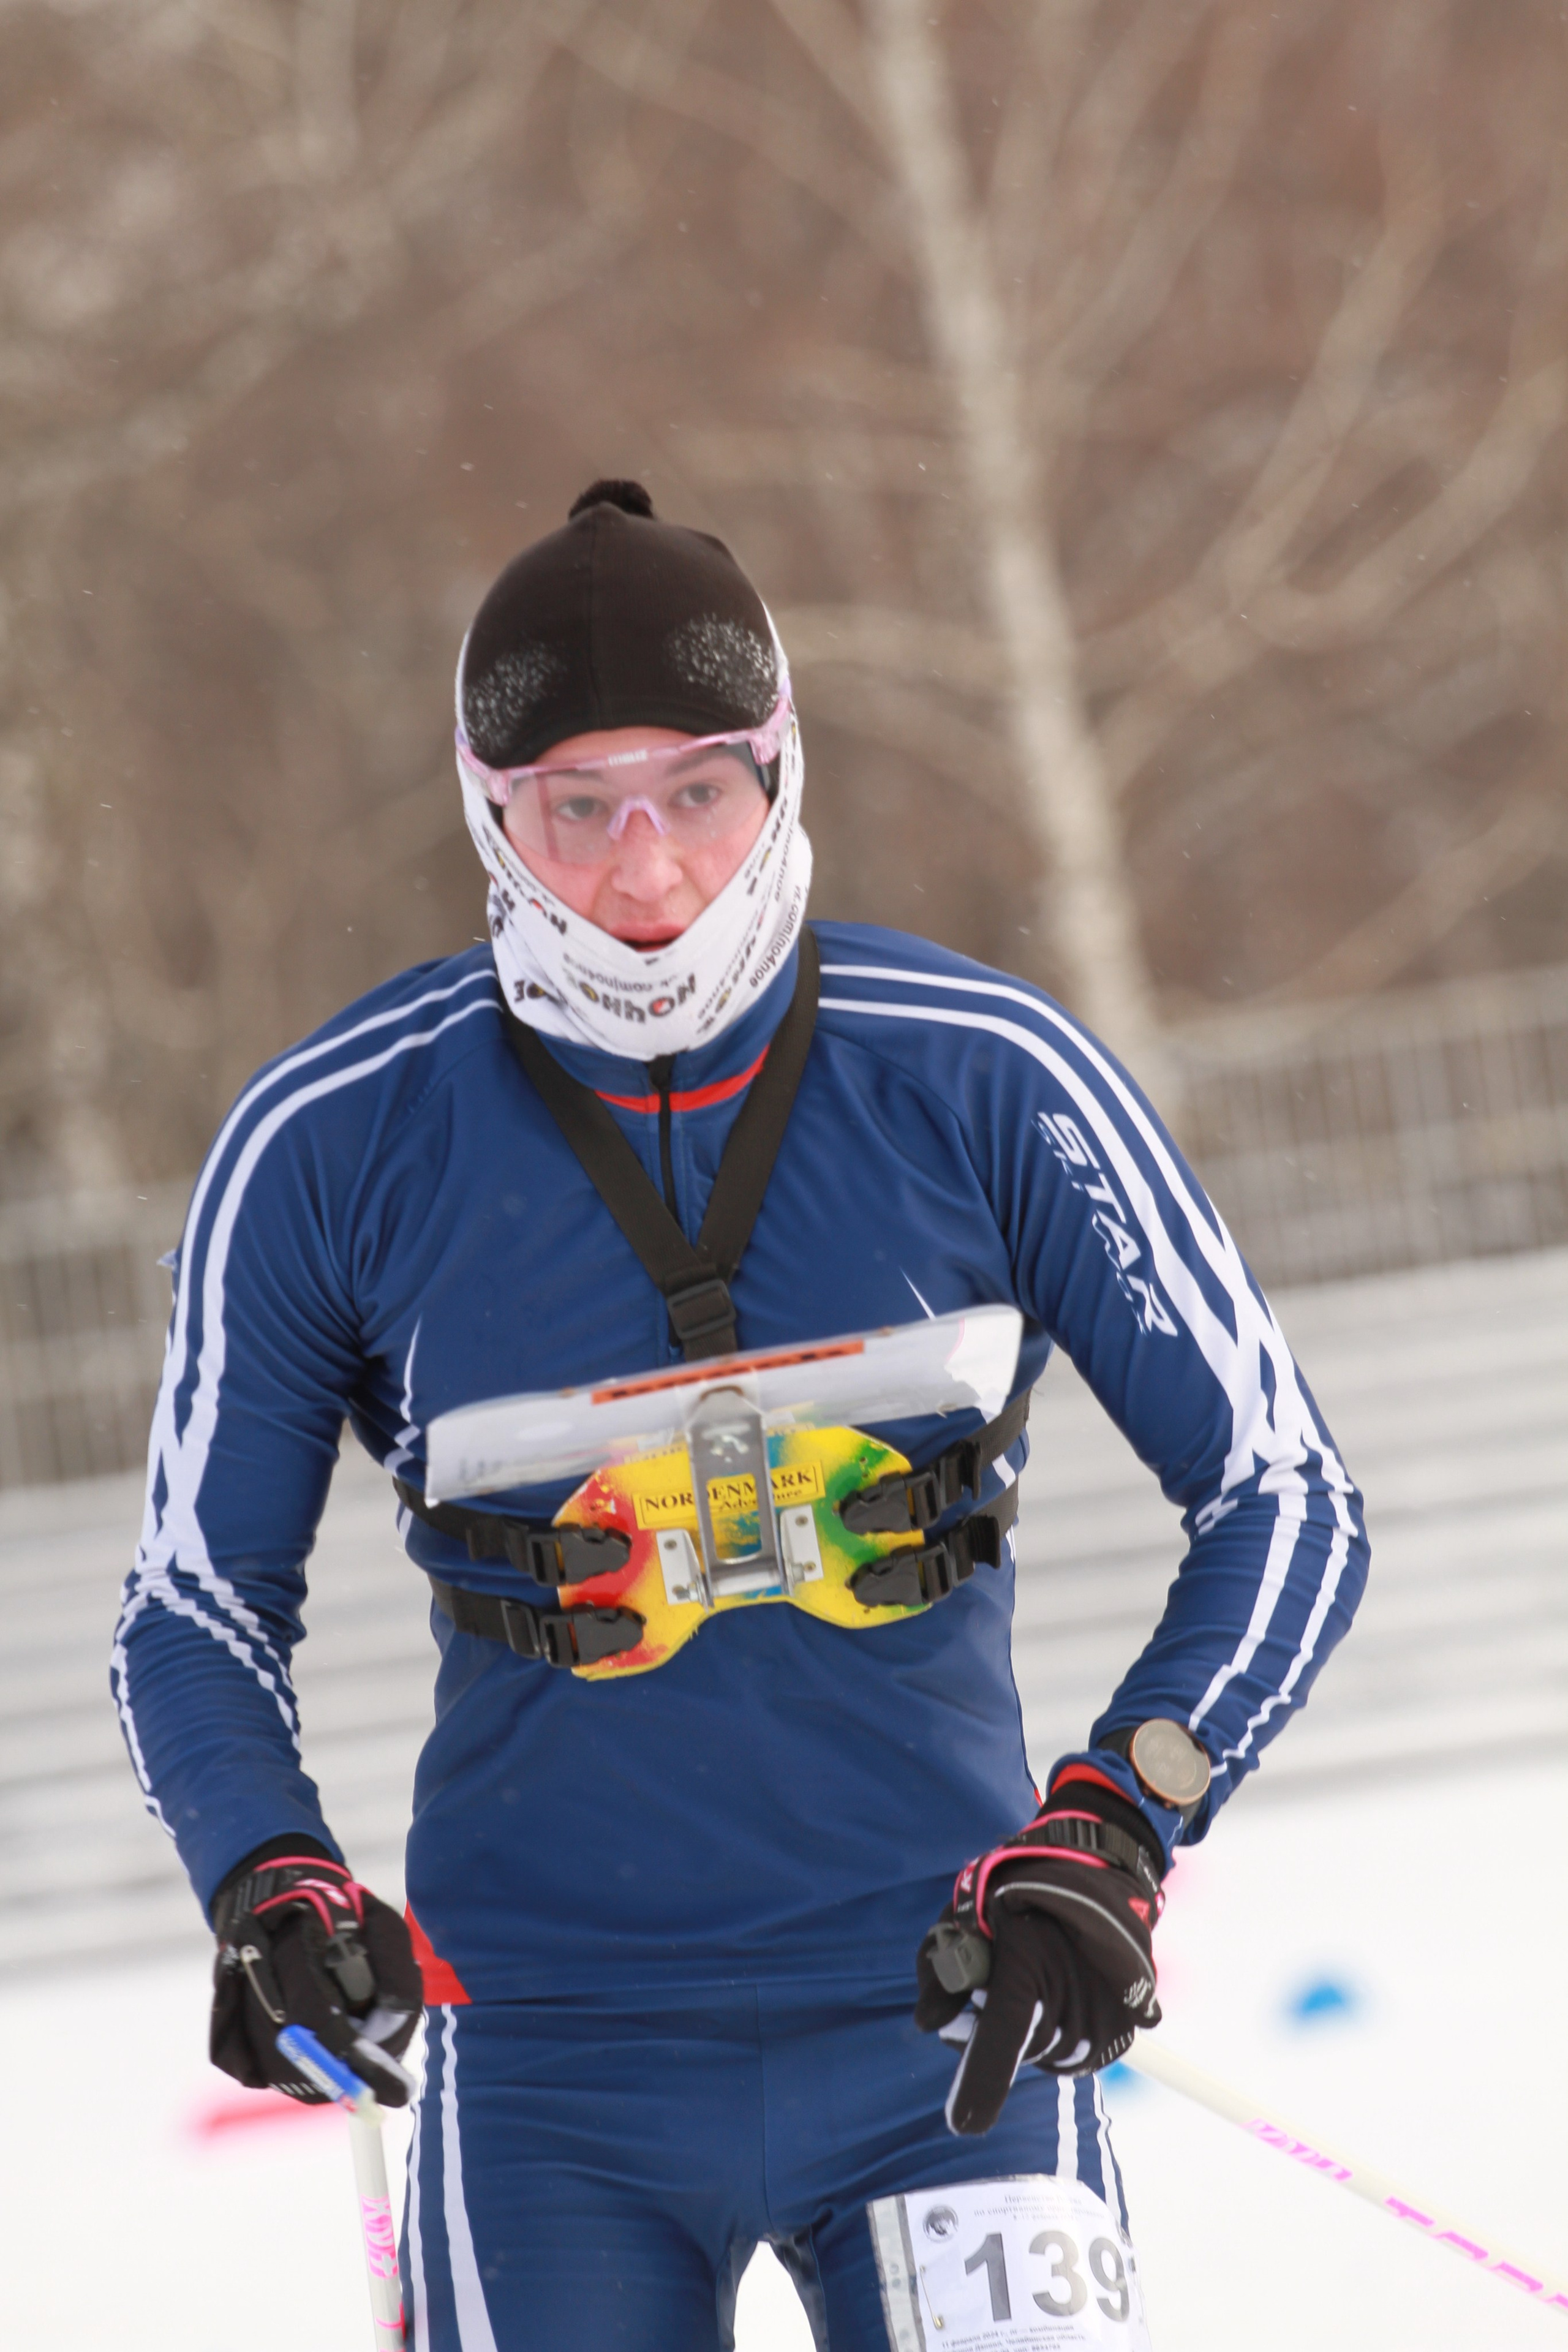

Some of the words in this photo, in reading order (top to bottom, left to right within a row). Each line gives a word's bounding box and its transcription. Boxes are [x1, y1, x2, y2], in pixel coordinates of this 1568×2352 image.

[1038, 1111, 1178, 1336] STAR
[644, 1469, 813, 1512] NORENMRK
[963, 2230, 1130, 2323] 139
